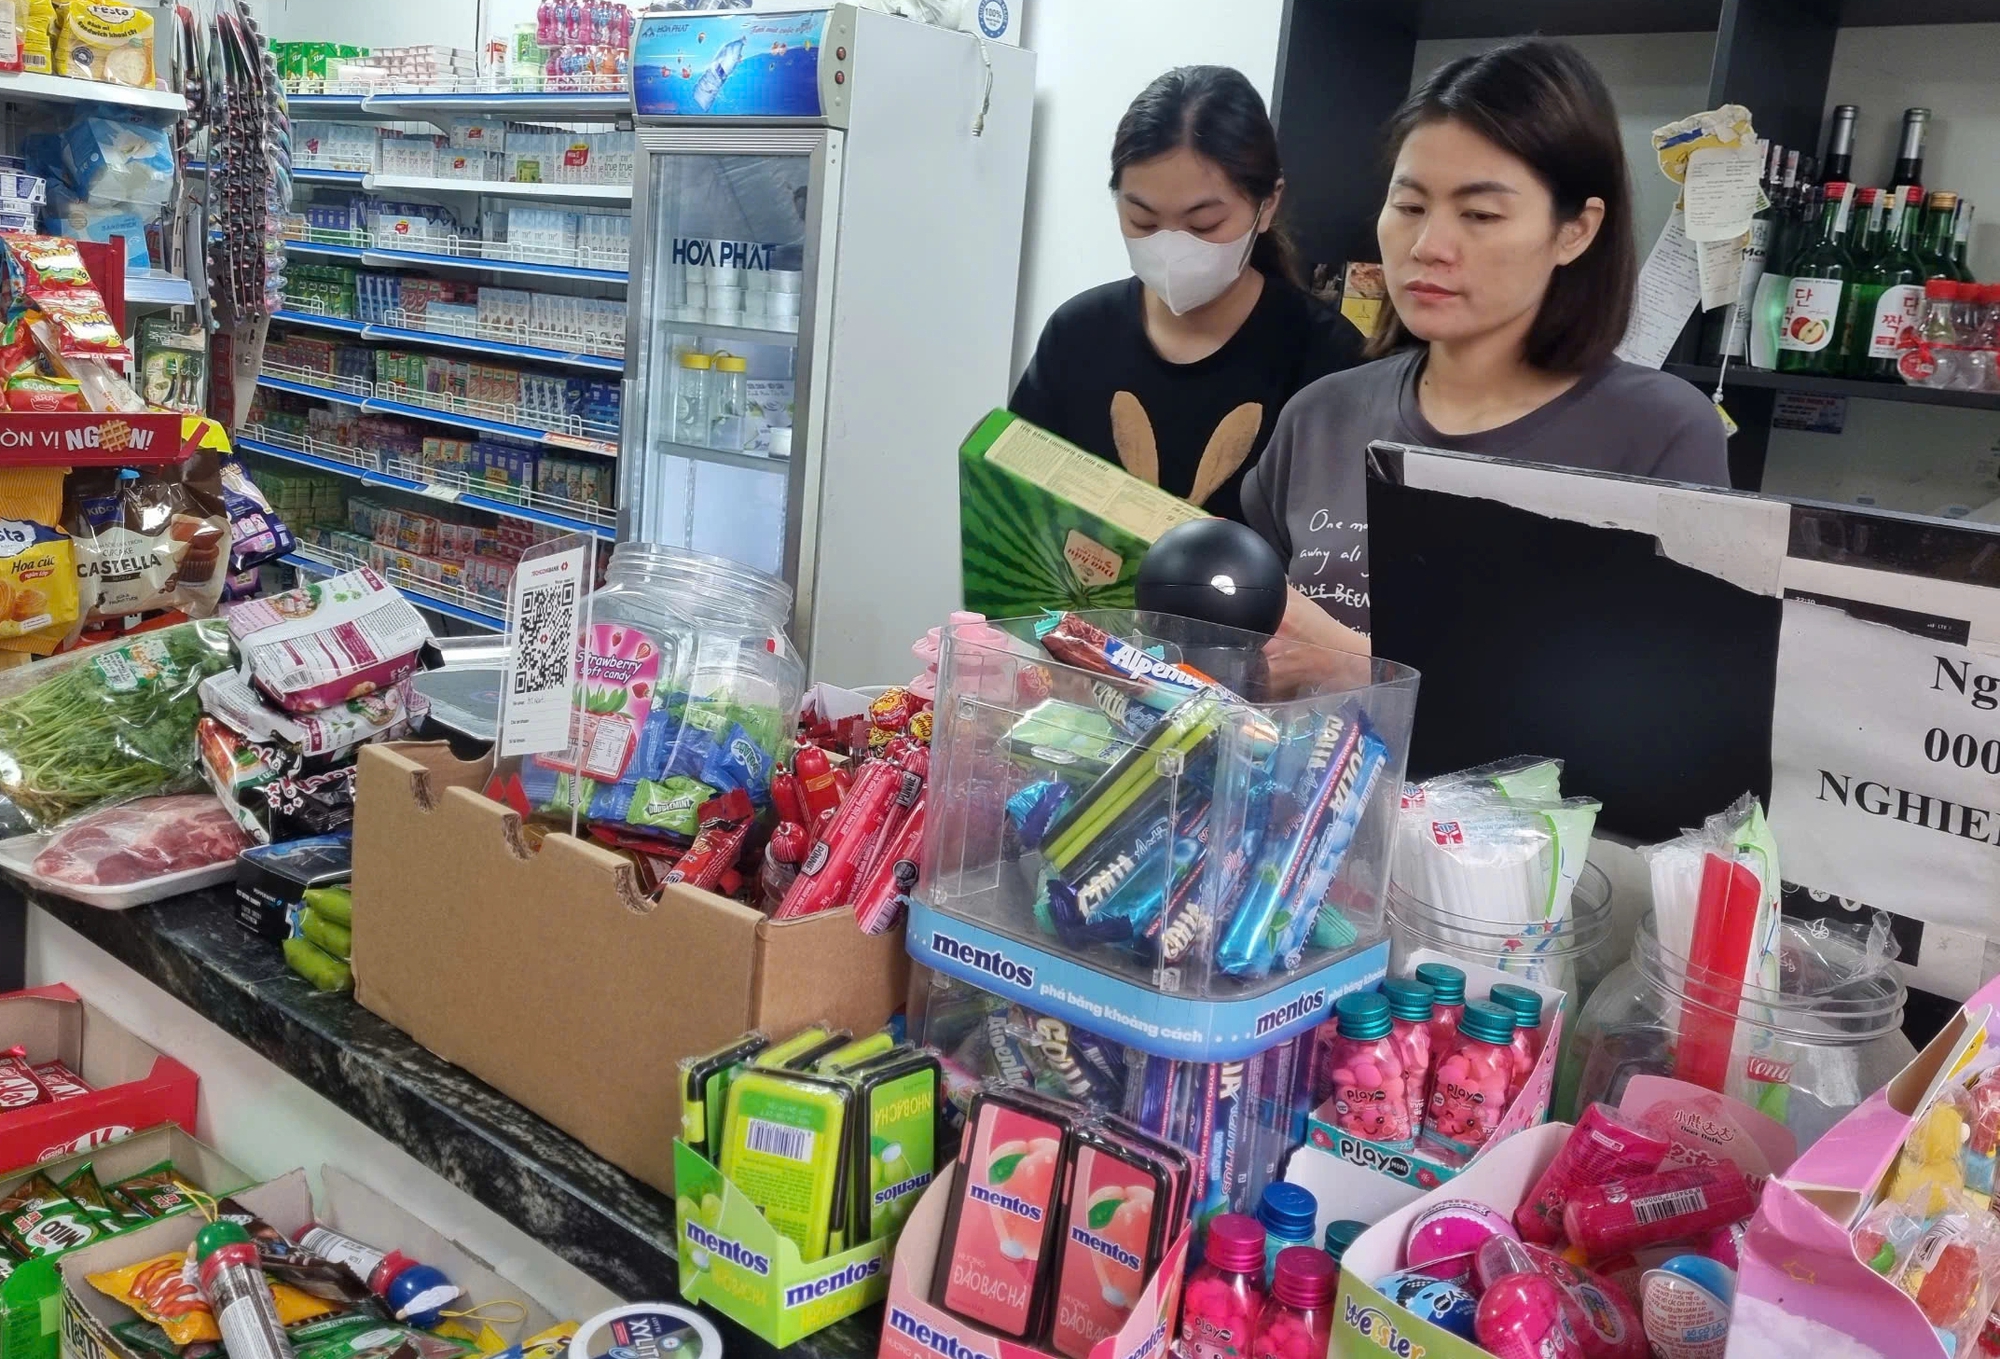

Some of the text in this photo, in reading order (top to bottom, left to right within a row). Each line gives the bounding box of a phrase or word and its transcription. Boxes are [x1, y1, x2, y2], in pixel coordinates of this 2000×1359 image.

[618, 163, 633, 172] true
[673, 239, 776, 271] HÒA PHÁT
[40, 431, 59, 449] VỊ
[1310, 509, 1343, 532] One
[11, 555, 55, 574] Hoa cúc
[76, 553, 162, 578] CASTELLA
[1341, 545, 1361, 562] all
[576, 651, 642, 675] Strawberry
[603, 671, 632, 685] candy
[802, 842, 829, 876] PONNIE
[931, 931, 1034, 989] mentos
[1039, 983, 1067, 1003] phá
[1159, 1026, 1203, 1044] cách
[1254, 987, 1326, 1039] mentos
[1390, 1160, 1409, 1173] MORE
[874, 1172, 933, 1207] mentos
[969, 1184, 1042, 1222] mentos
[40, 1220, 85, 1249] MILO
[686, 1220, 770, 1277] mentos
[1071, 1226, 1141, 1272] mentos
[785, 1255, 882, 1309] mentos
